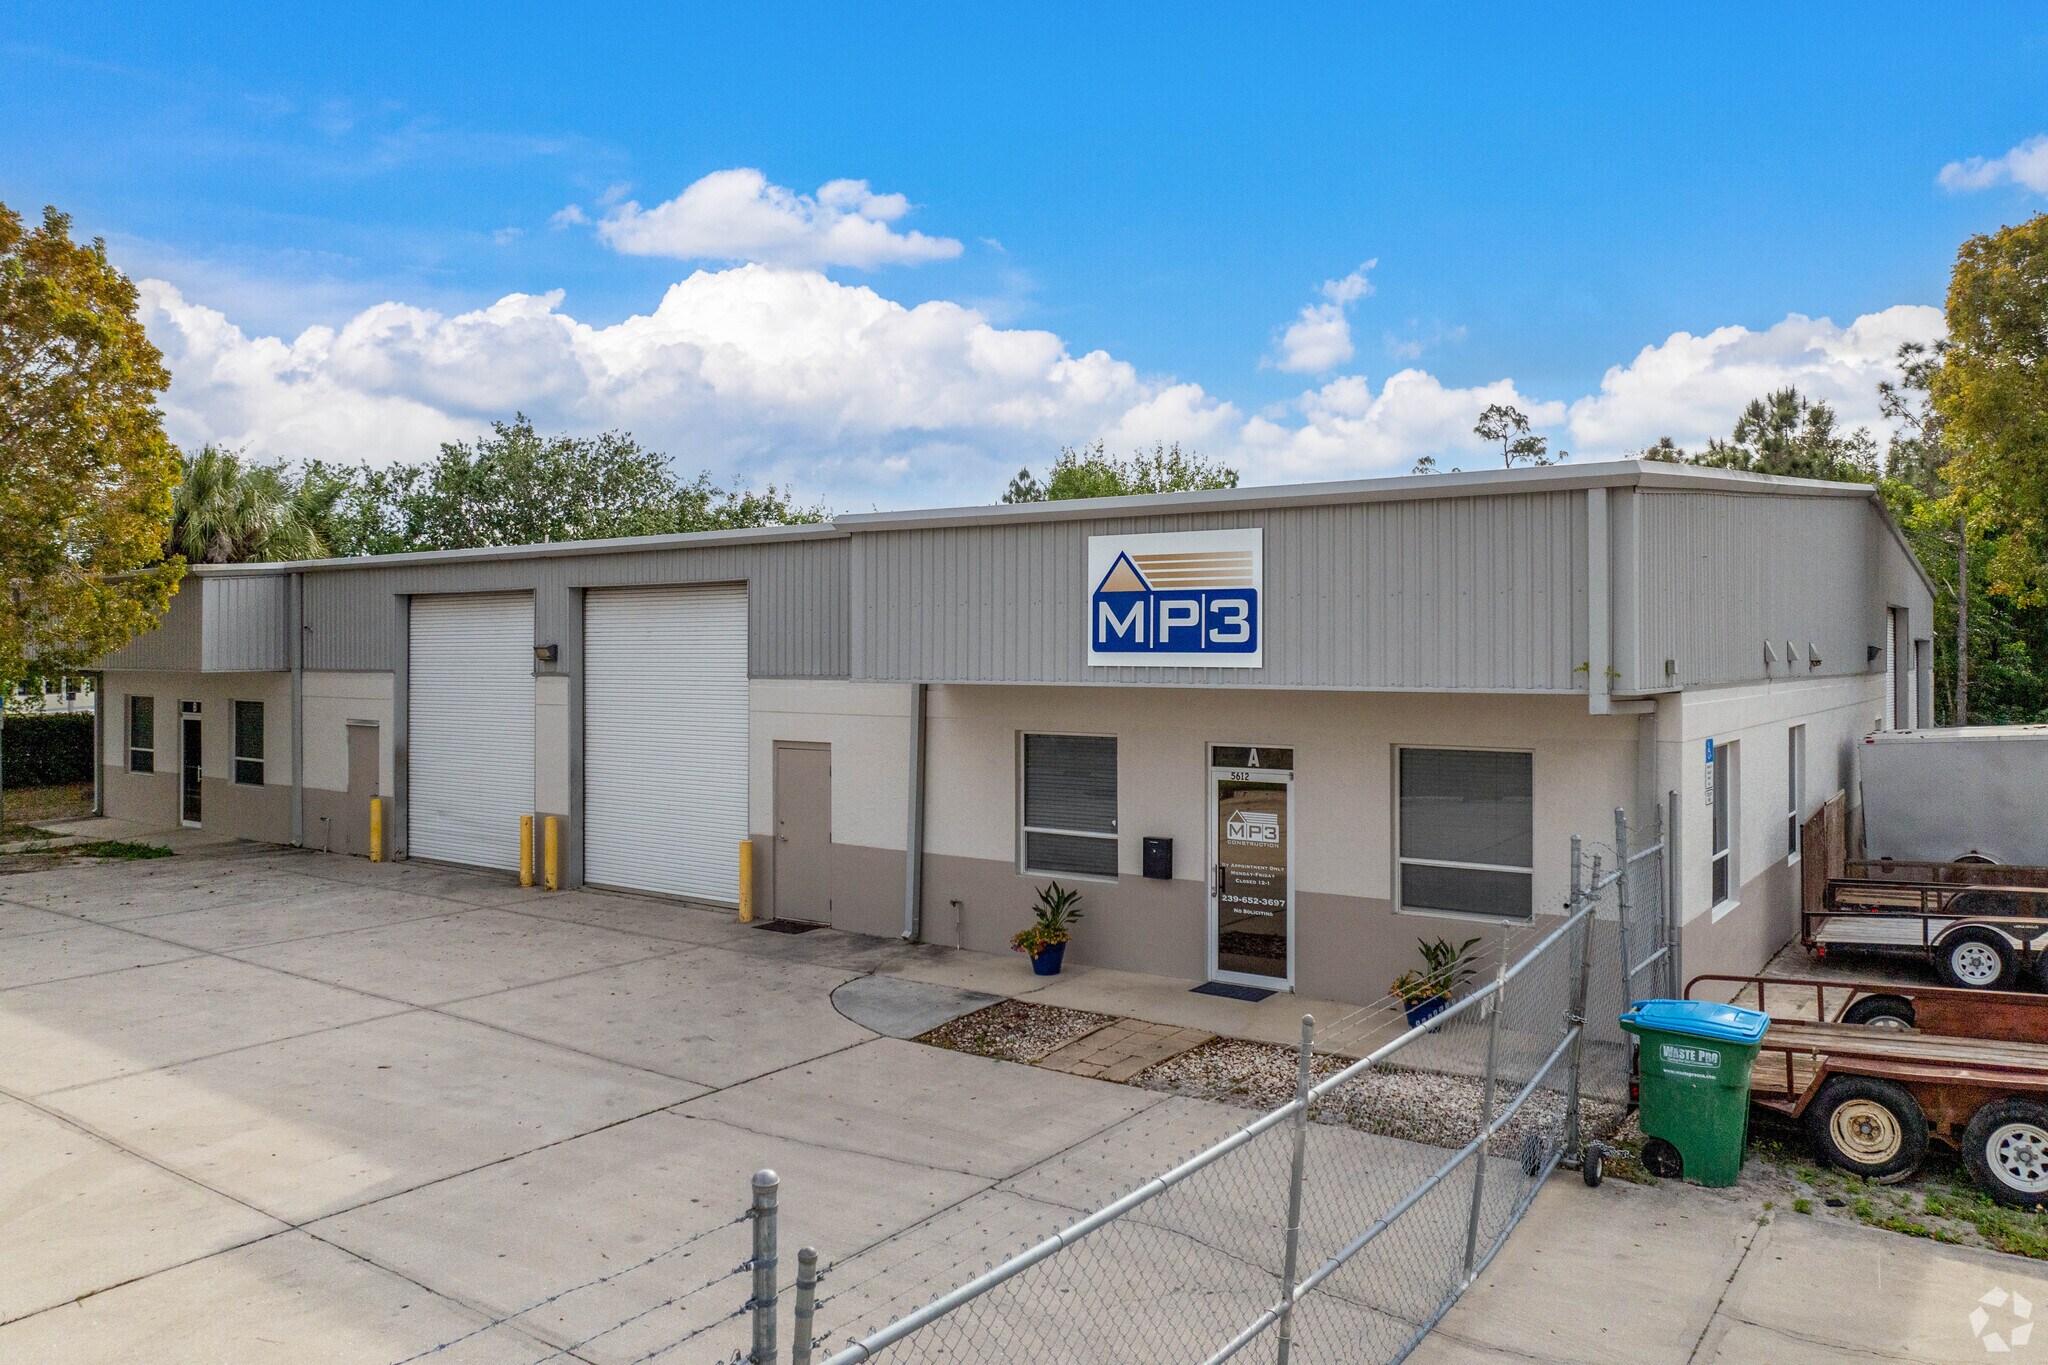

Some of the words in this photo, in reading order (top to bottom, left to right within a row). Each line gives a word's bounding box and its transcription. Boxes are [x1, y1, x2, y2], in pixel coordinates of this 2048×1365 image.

[1247, 748, 1260, 767] A
[1230, 772, 1250, 780] 5612
[1227, 840, 1280, 848] CONSTRUCTION
[1230, 870, 1276, 878] MONDAY-FRIDAY
[1221, 894, 1286, 907] 239-652-3697
[1242, 908, 1274, 916] SOLICITING
[1663, 1045, 1696, 1060] WASTE
[1698, 1050, 1718, 1064] PRO
